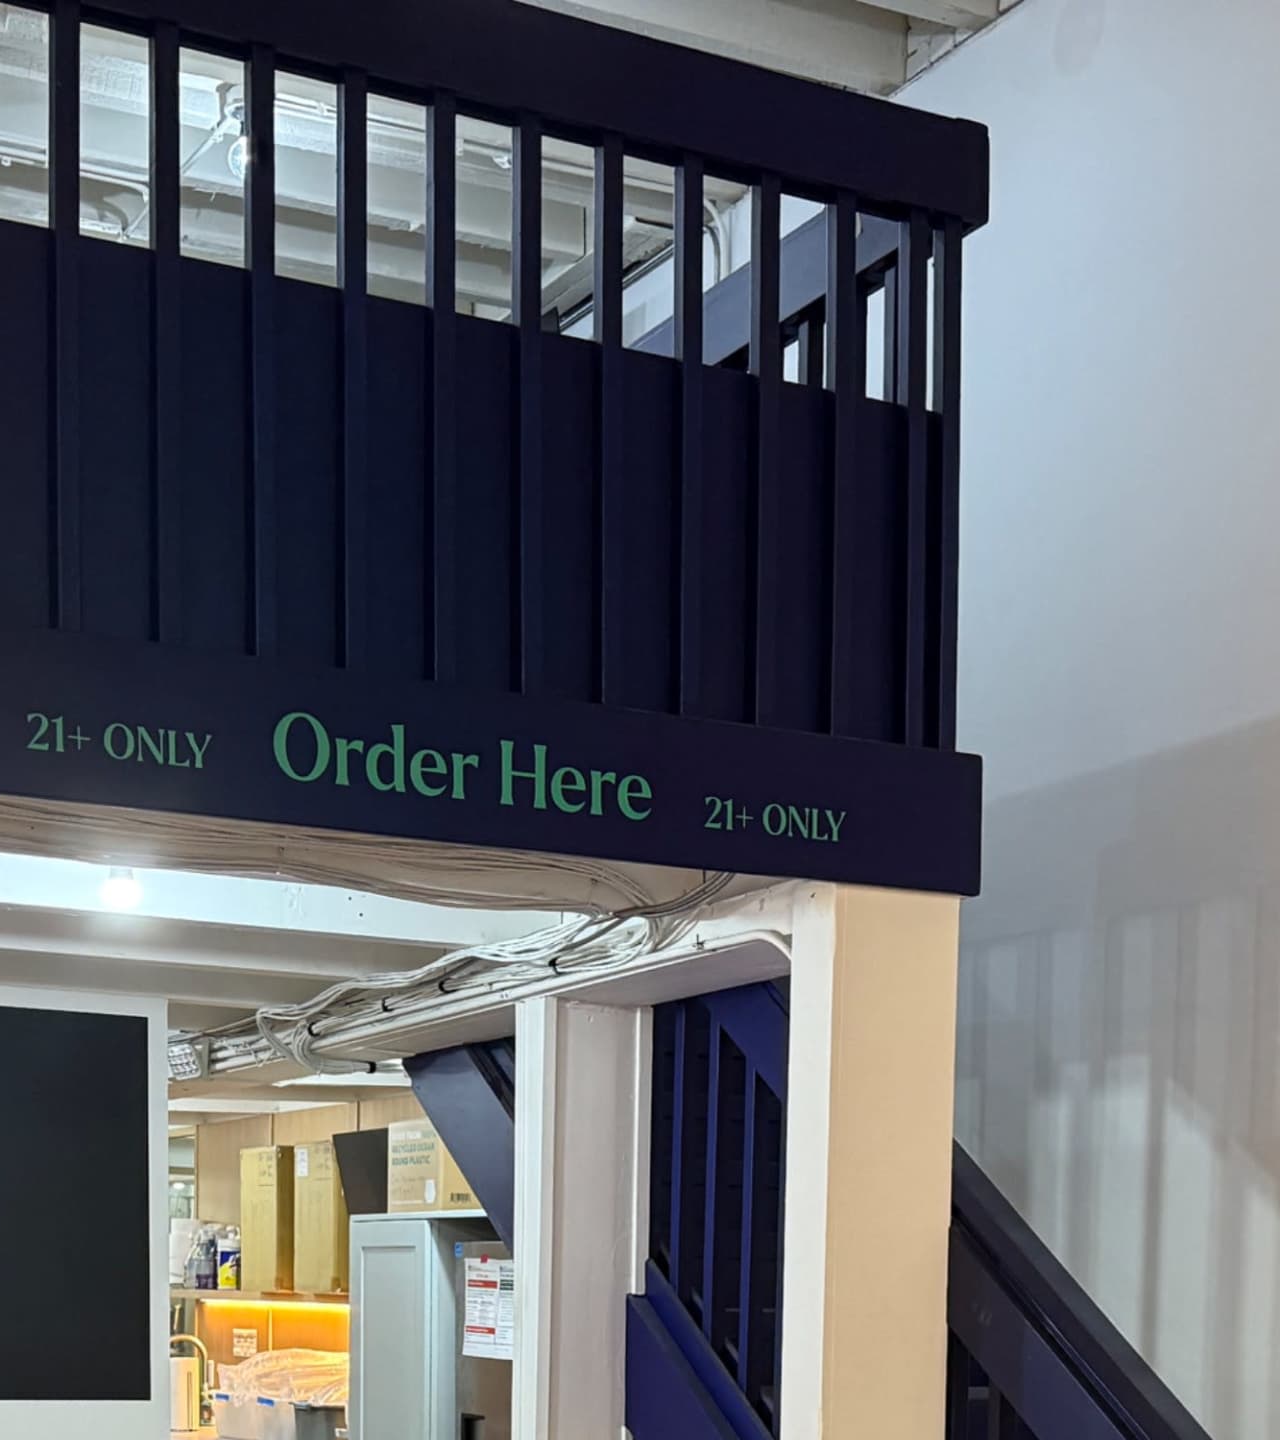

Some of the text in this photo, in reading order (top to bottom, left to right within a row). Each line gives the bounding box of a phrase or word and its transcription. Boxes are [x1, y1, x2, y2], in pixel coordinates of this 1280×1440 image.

[25, 712, 212, 770] 21+ ONLY
[273, 712, 653, 822] Order Here
[703, 796, 847, 842] 21+ ONLY
